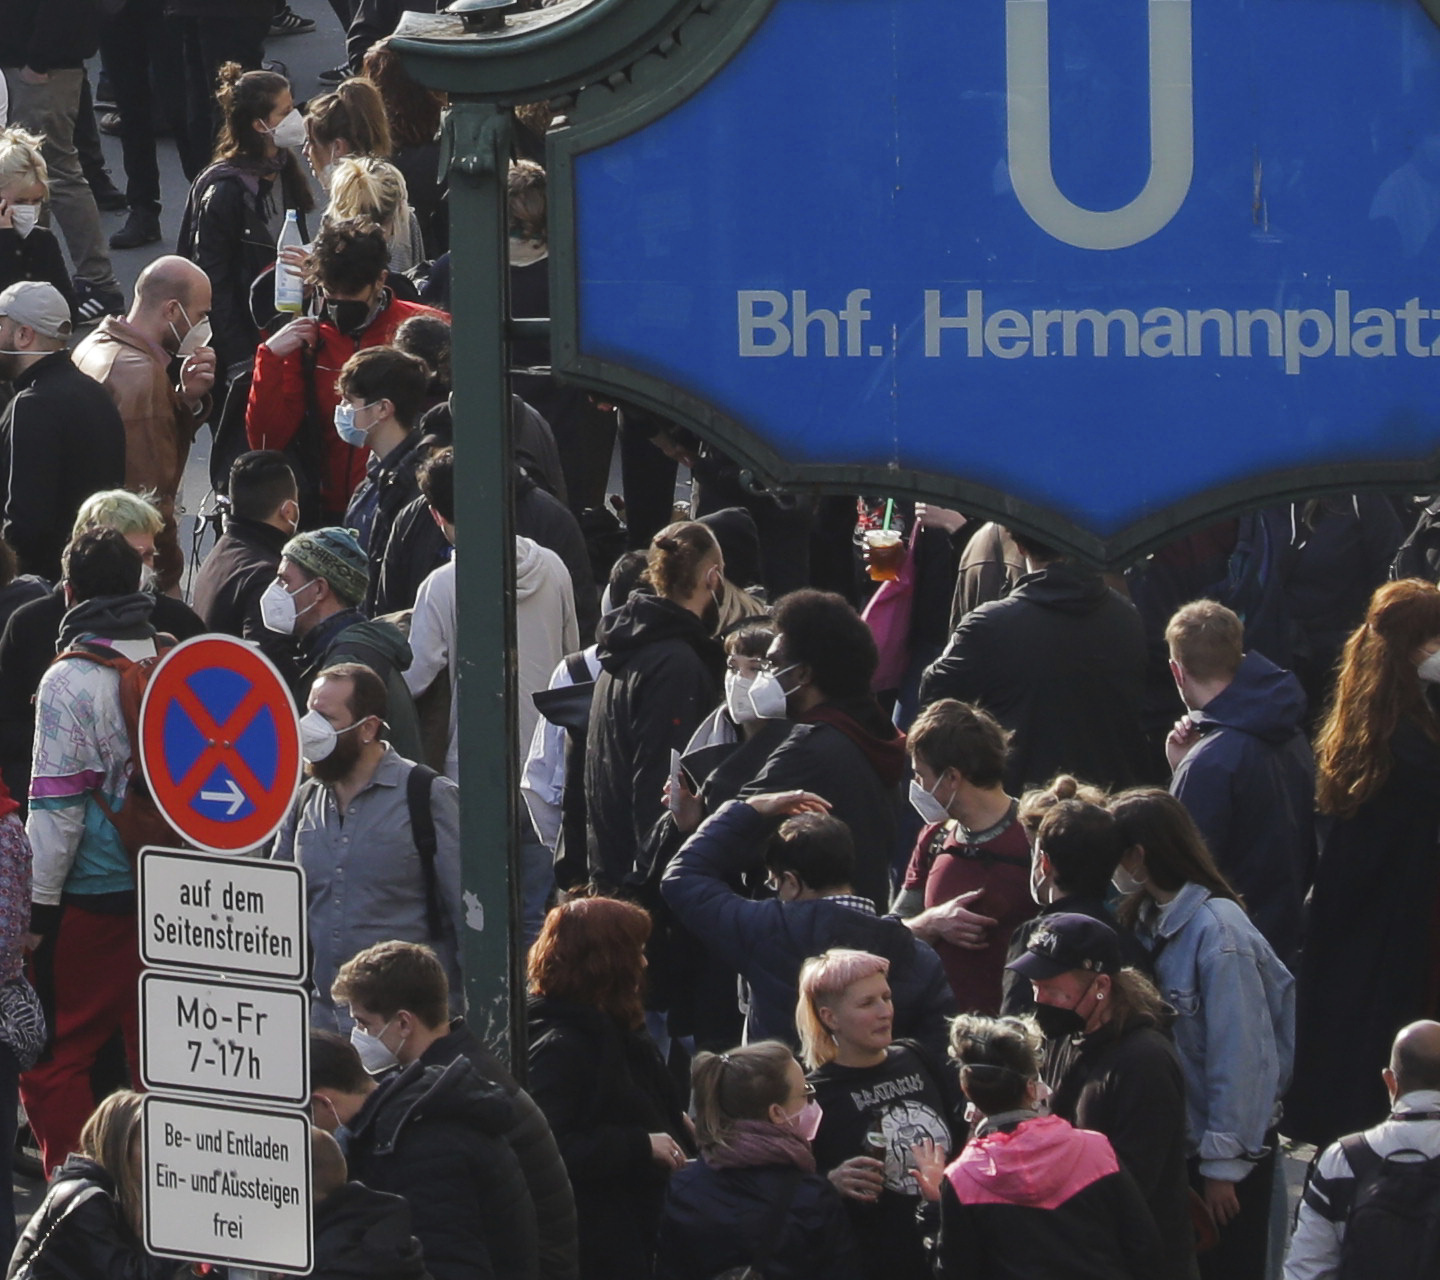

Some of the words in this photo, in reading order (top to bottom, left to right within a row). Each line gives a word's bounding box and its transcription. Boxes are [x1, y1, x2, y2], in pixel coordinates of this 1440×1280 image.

[736, 288, 884, 359] Bhf.
[180, 879, 212, 908] auf
[222, 880, 265, 914] dem
[153, 913, 293, 959] Seitenstreifen
[176, 994, 268, 1037] Mo-Fr
[187, 1040, 261, 1081] 7-17h
[164, 1122, 192, 1148] Be-
[196, 1128, 222, 1154] und
[226, 1130, 289, 1163] Entladen
[156, 1162, 187, 1189] Ein-
[191, 1167, 218, 1195] und
[221, 1171, 300, 1210] Aussteigen
[212, 1212, 244, 1240] frei
